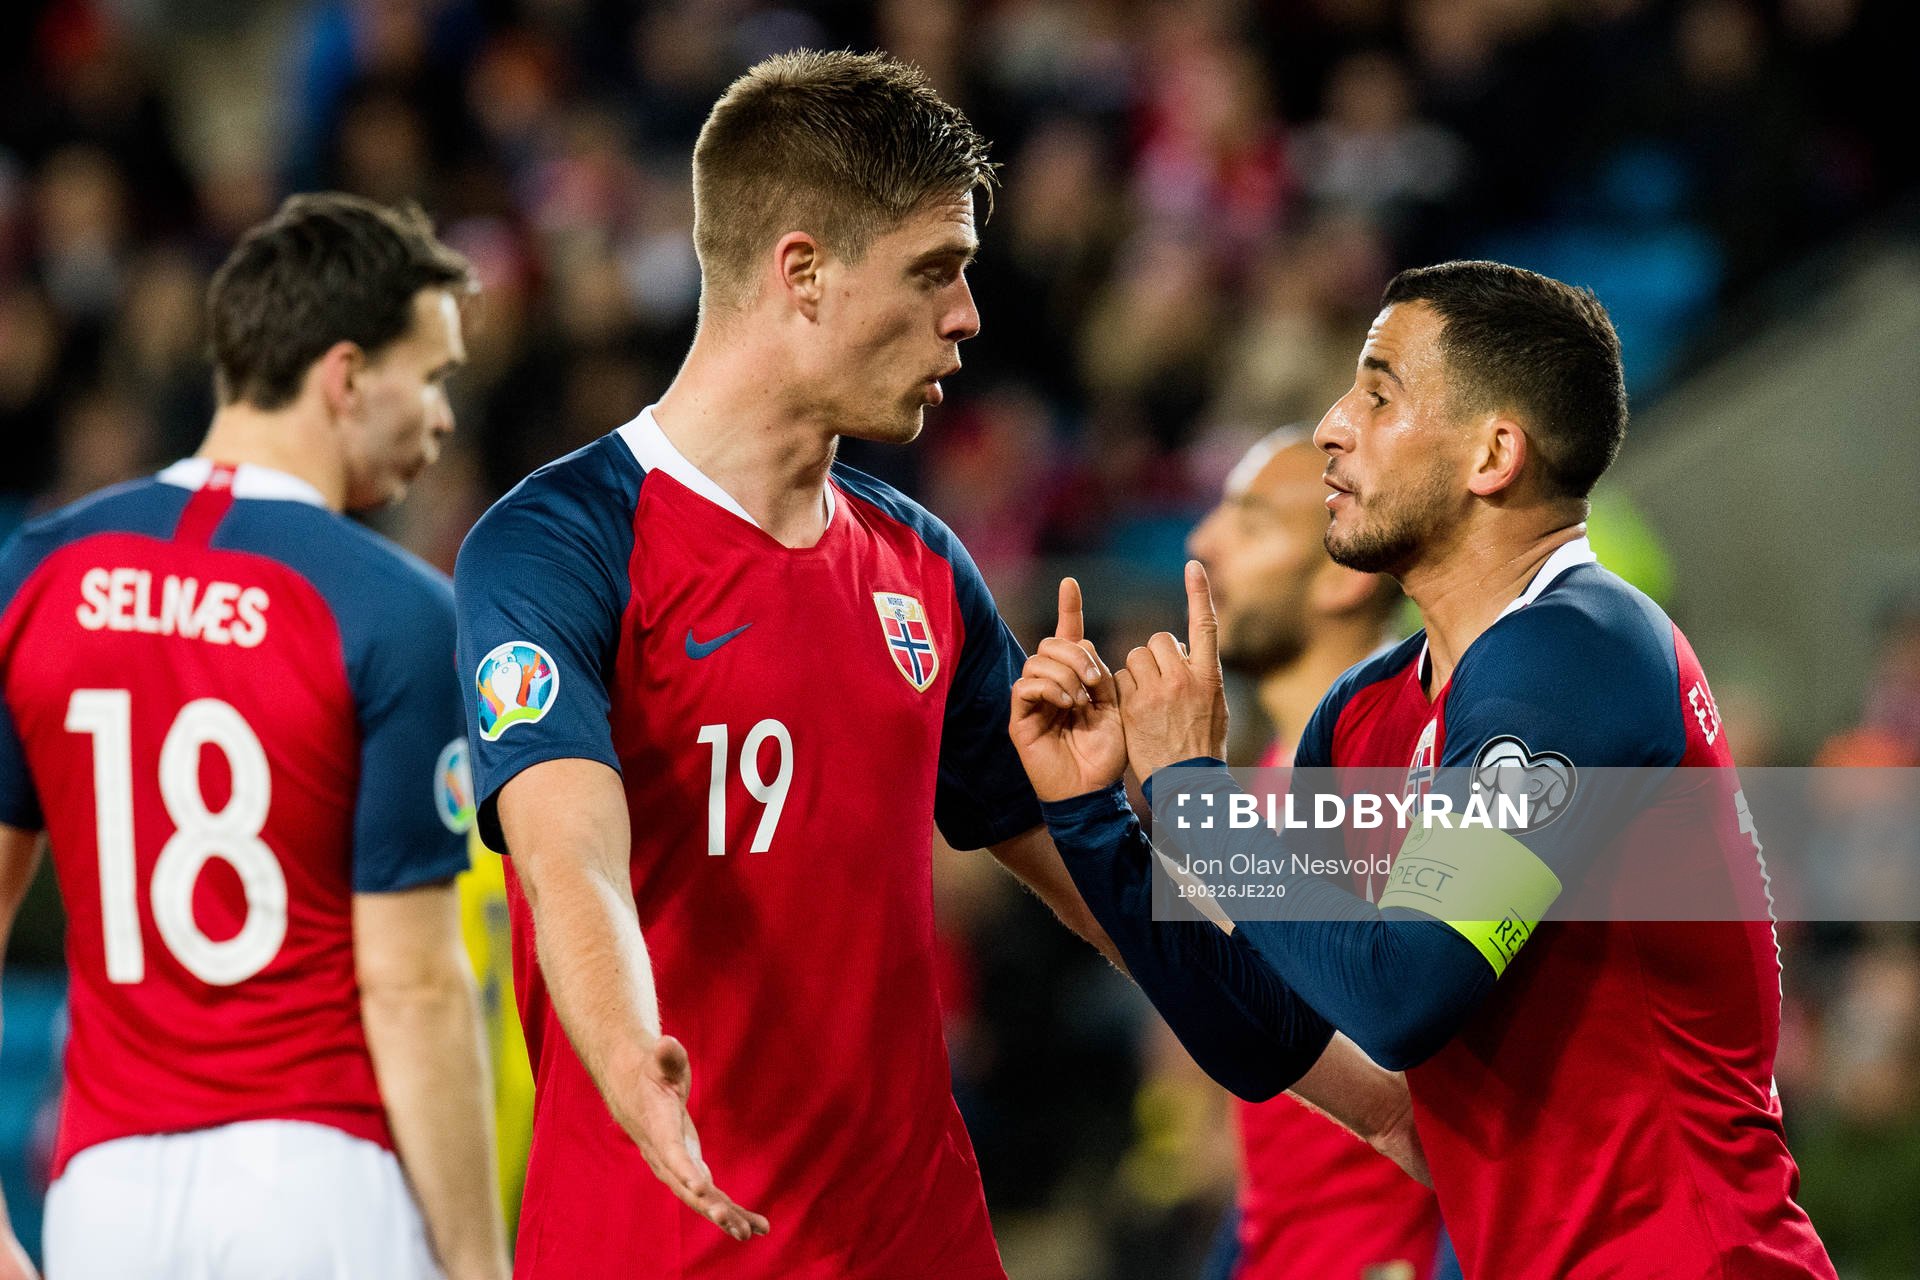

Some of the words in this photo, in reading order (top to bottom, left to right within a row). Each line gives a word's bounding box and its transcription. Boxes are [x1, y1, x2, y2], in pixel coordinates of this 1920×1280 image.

[77, 568, 270, 647] SELNÆS
[65, 689, 288, 986] 18
[697, 718, 793, 855] 19
